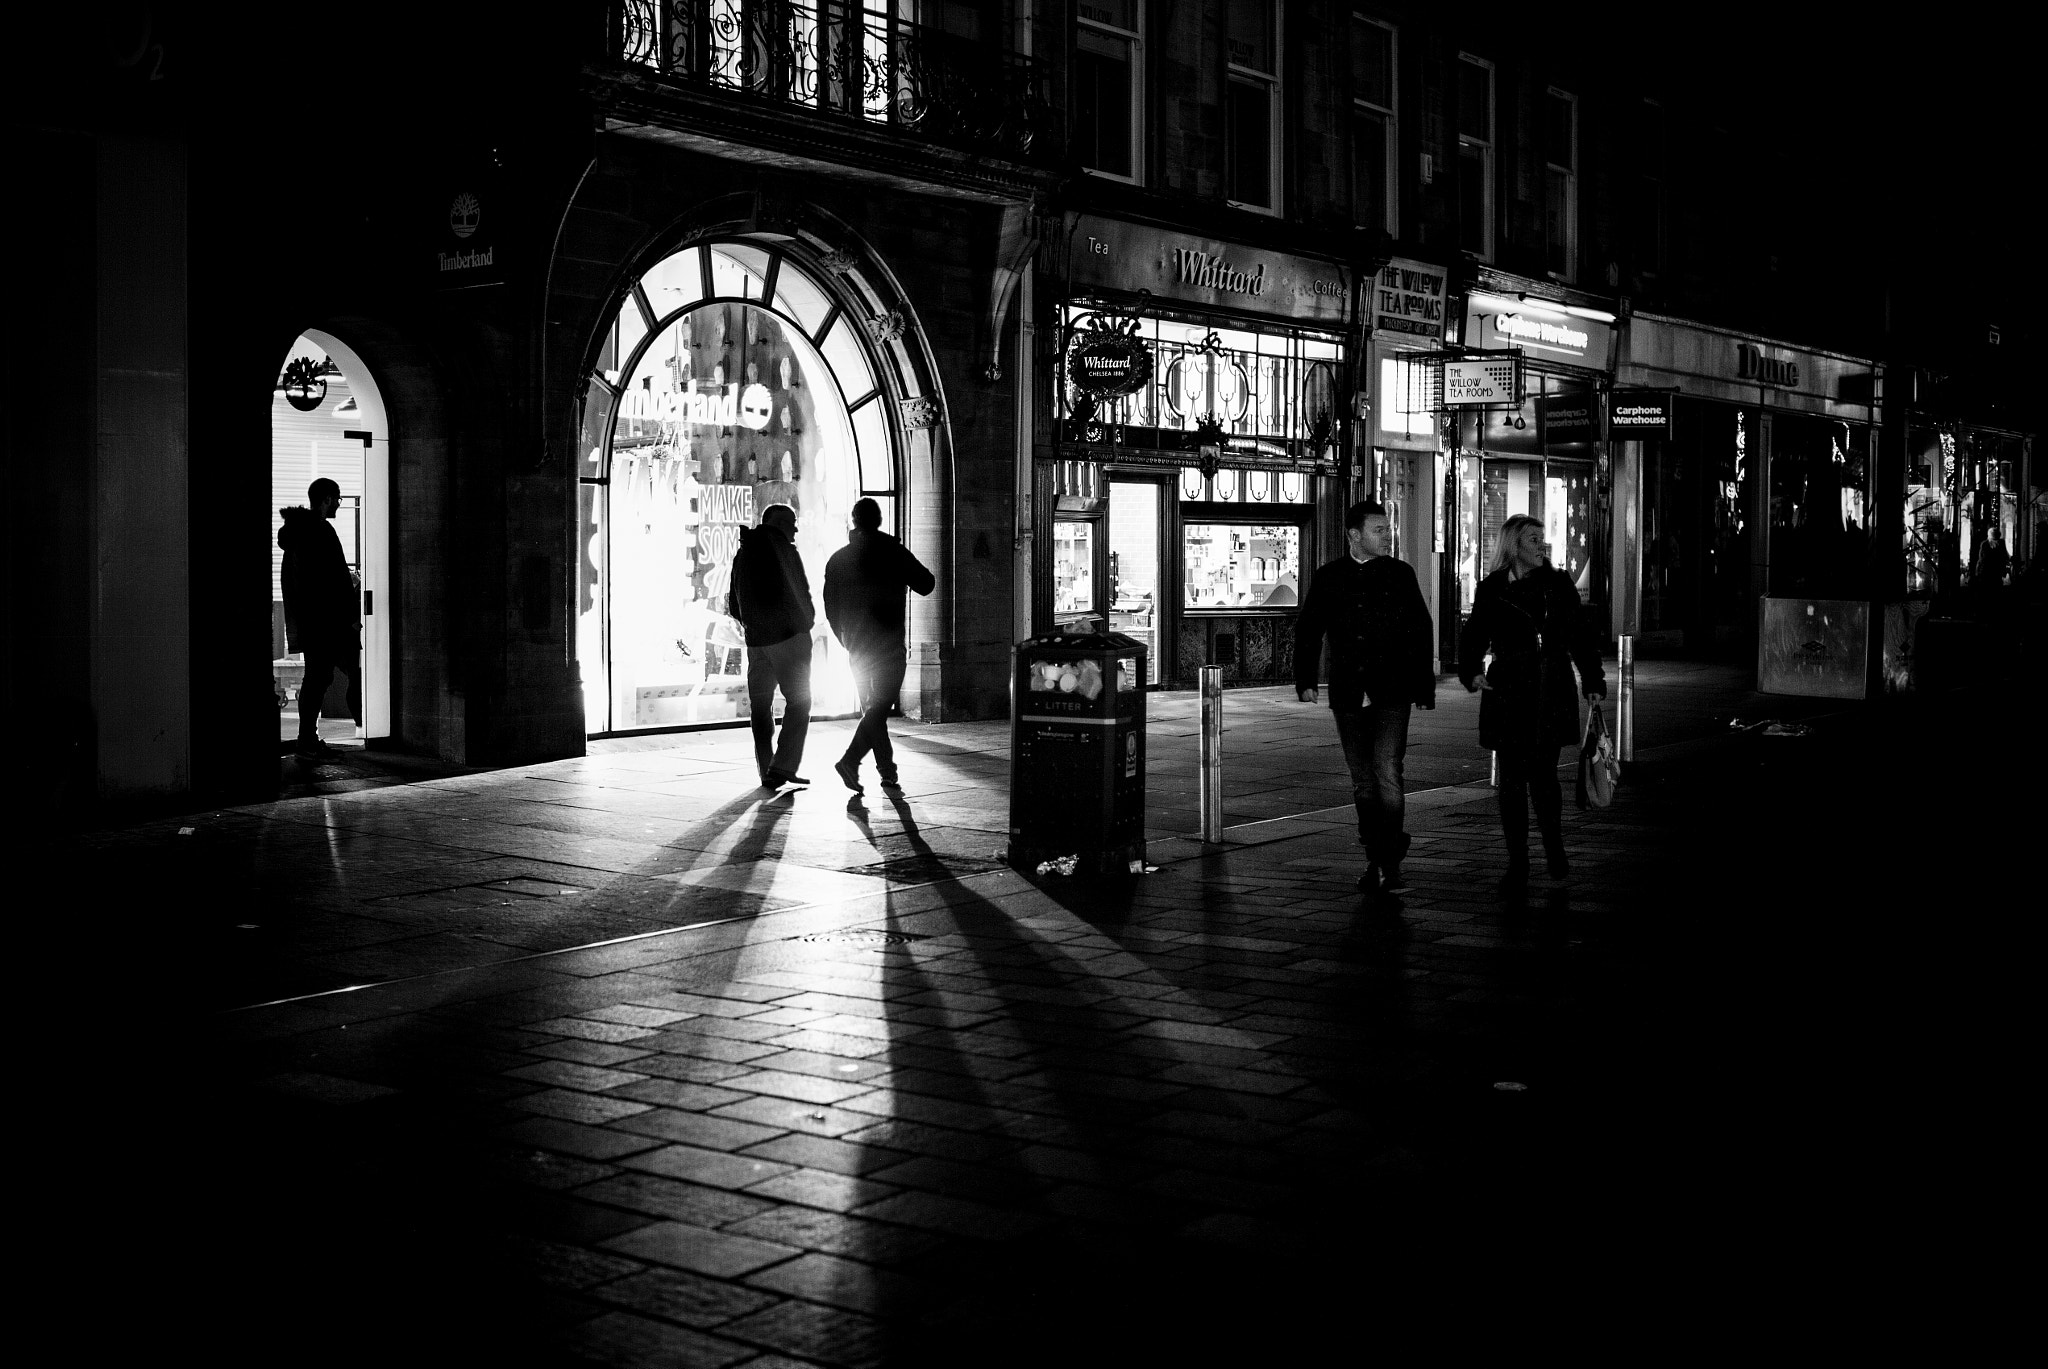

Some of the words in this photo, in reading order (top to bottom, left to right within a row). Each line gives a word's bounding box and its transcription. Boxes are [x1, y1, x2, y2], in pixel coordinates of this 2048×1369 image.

[1088, 236, 1109, 255] Tea
[438, 246, 493, 271] Timberland
[1176, 248, 1266, 297] Whittard
[1380, 266, 1400, 289] THE
[1313, 279, 1348, 299] Coffee
[1379, 289, 1402, 315] TEA
[1403, 294, 1442, 321] ROOMS
[1083, 355, 1131, 369] Whittard
[1737, 343, 1799, 387] Dune
[1449, 368, 1462, 377] THE
[1449, 377, 1482, 387] WILLOW
[1449, 388, 1463, 398] TEA
[1466, 387, 1494, 398] ROOMS
[1612, 416, 1667, 425] Warehouse
[1615, 405, 1662, 417] Carphone
[700, 484, 753, 524] MAKE
[699, 525, 741, 565] SOM
[1045, 701, 1081, 711] LITTER
